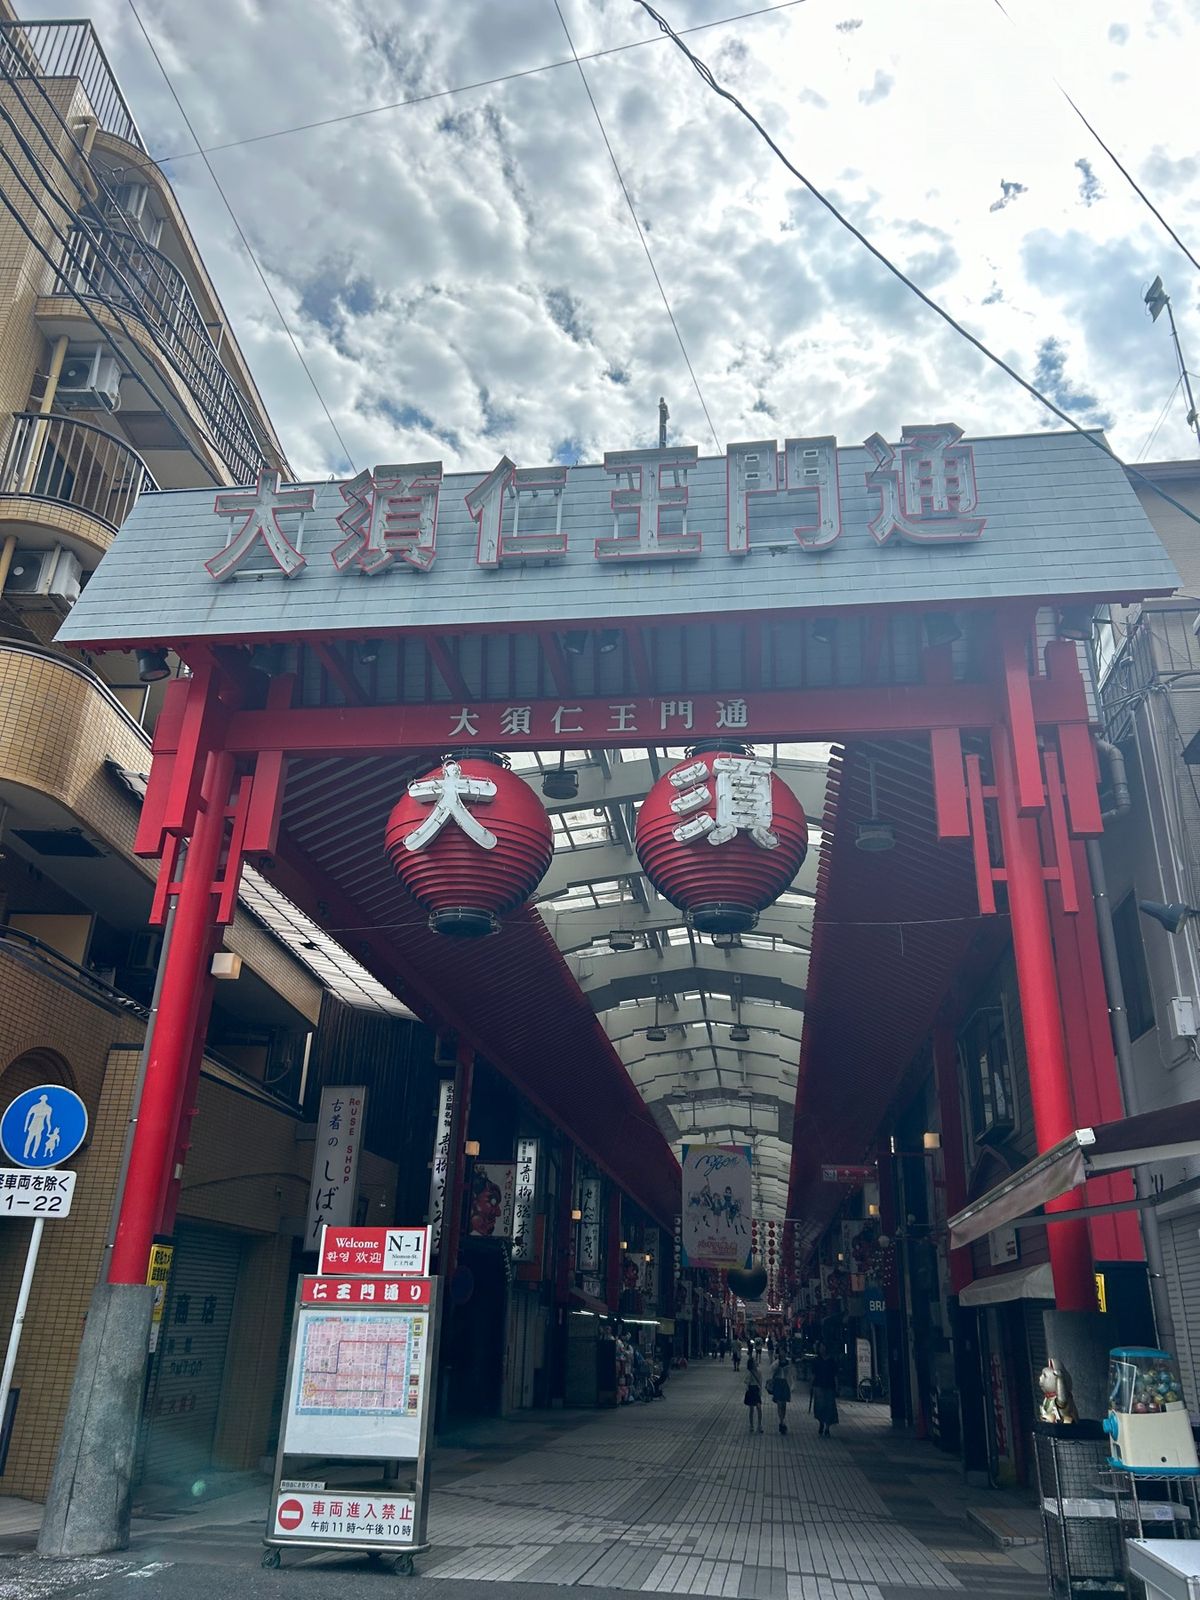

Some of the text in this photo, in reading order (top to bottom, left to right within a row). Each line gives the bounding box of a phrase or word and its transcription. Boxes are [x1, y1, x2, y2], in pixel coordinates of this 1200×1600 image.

[204, 422, 987, 582] 大須仁王門通
[448, 699, 750, 736] 大須仁王門通
[402, 760, 498, 852] 大
[668, 753, 781, 850] 須
[343, 1145, 353, 1184] SHOP
[326, 1251, 350, 1263] 환영
[335, 1235, 421, 1252] Welcome N-1
[355, 1251, 382, 1264] 欢迎
[312, 1282, 422, 1301] 仁王門通り
[311, 1500, 413, 1521] 車両進入禁止
